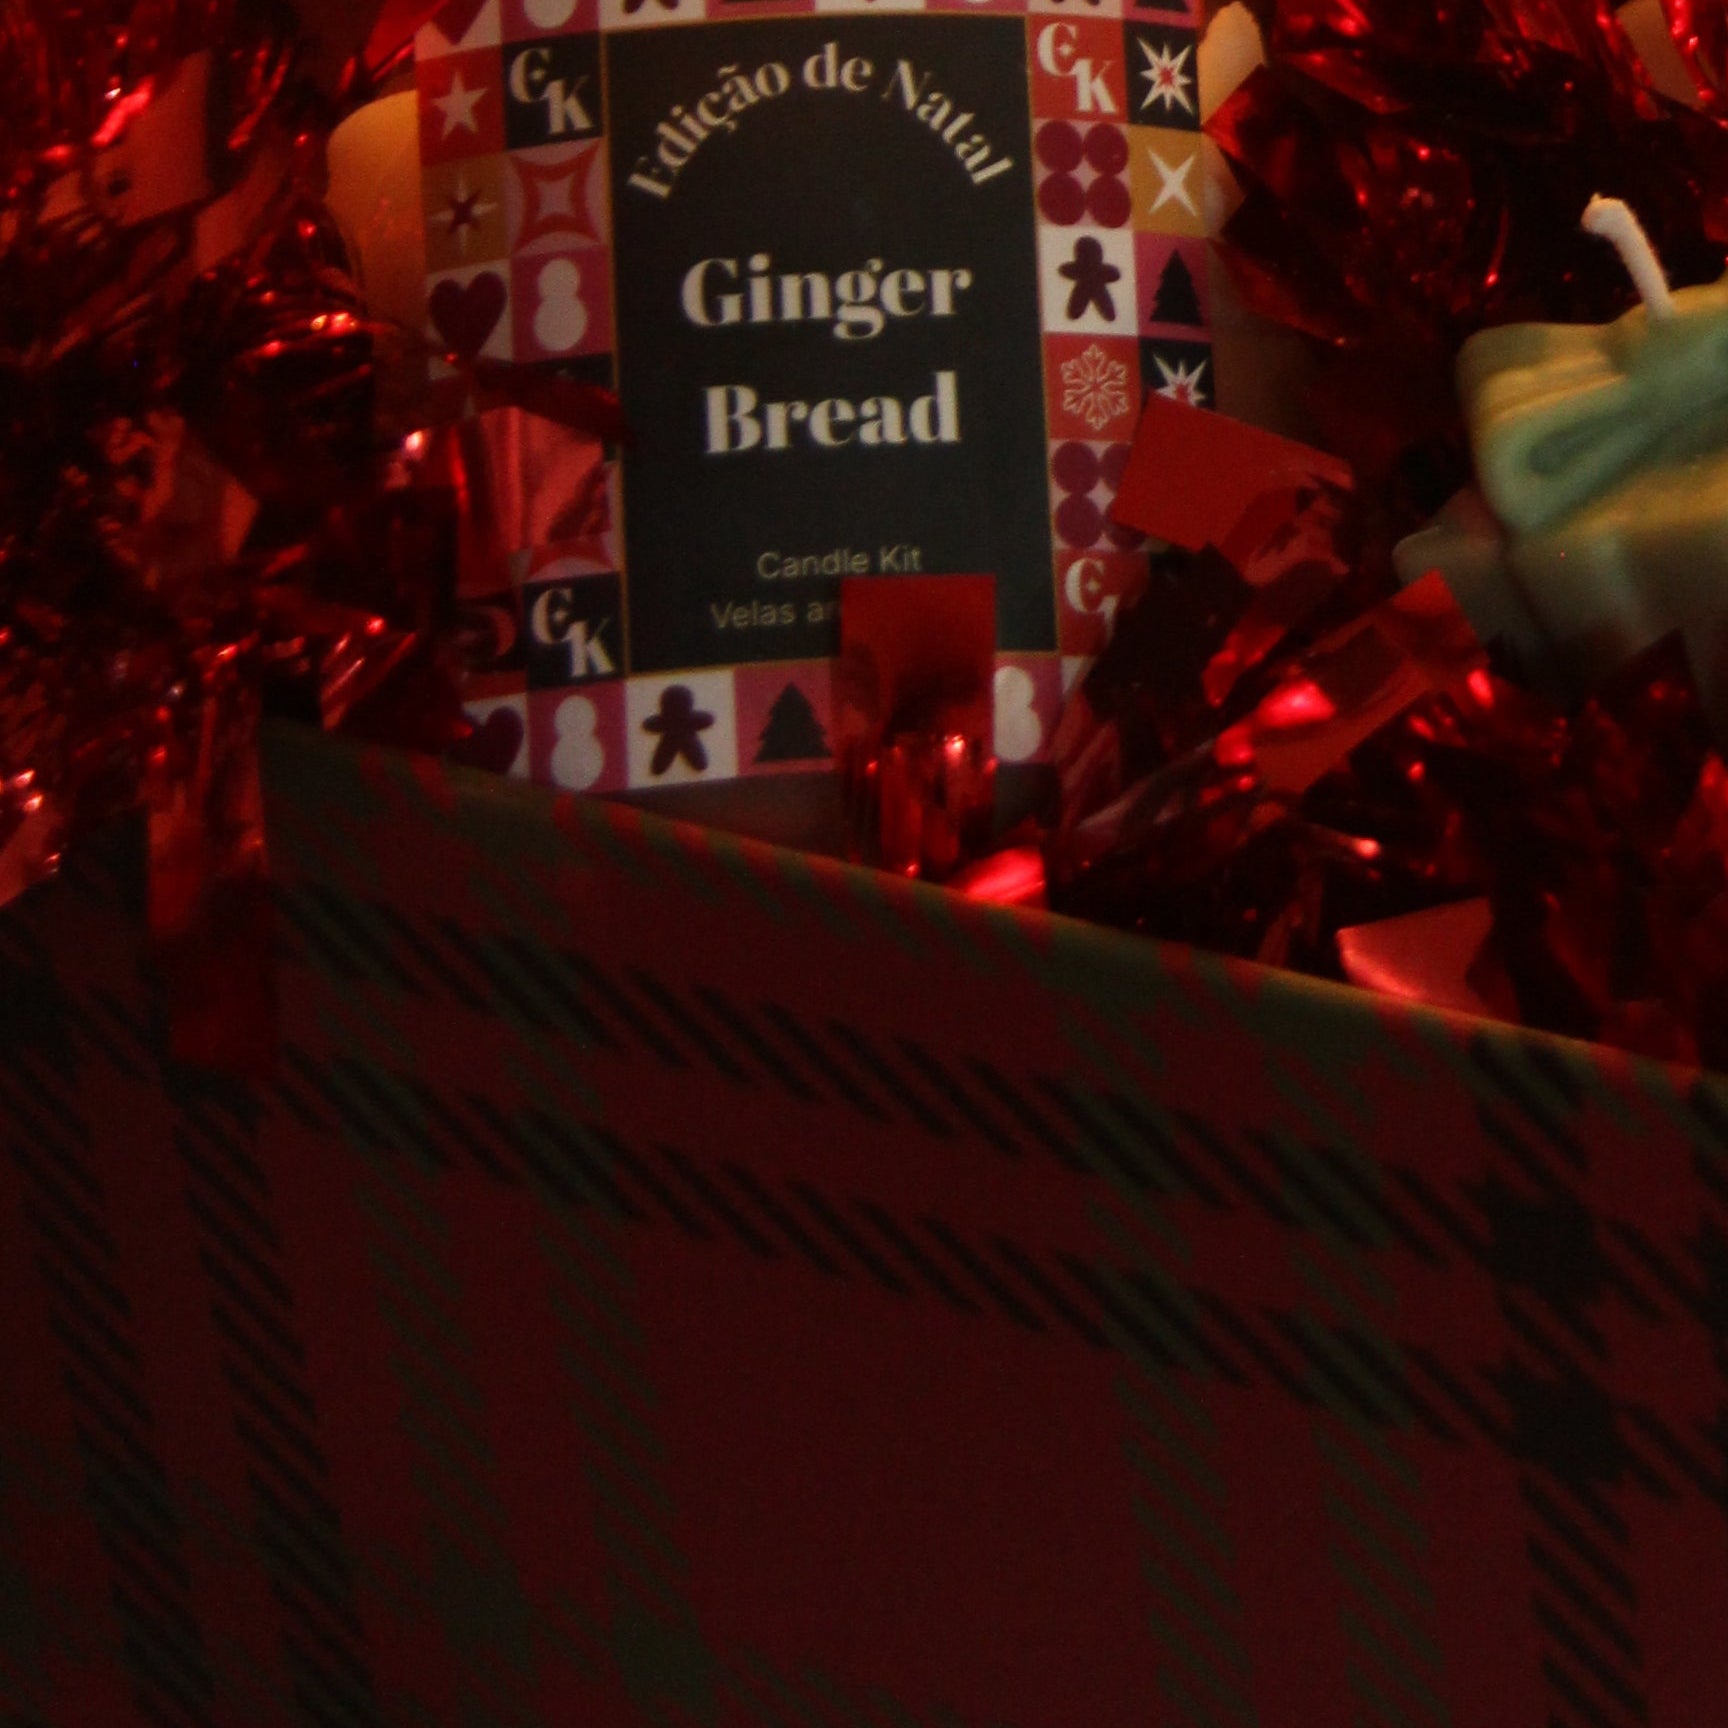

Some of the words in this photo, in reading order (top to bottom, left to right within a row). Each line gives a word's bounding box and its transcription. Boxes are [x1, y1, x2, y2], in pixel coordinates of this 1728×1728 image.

[626, 62, 792, 201] Edição
[803, 41, 876, 92] de
[882, 58, 1015, 185] Natal
[681, 253, 973, 341] Ginger
[703, 370, 961, 454] Bread
[756, 548, 871, 580] Candle
[880, 544, 922, 572] Kit
[709, 601, 797, 629] Velas
